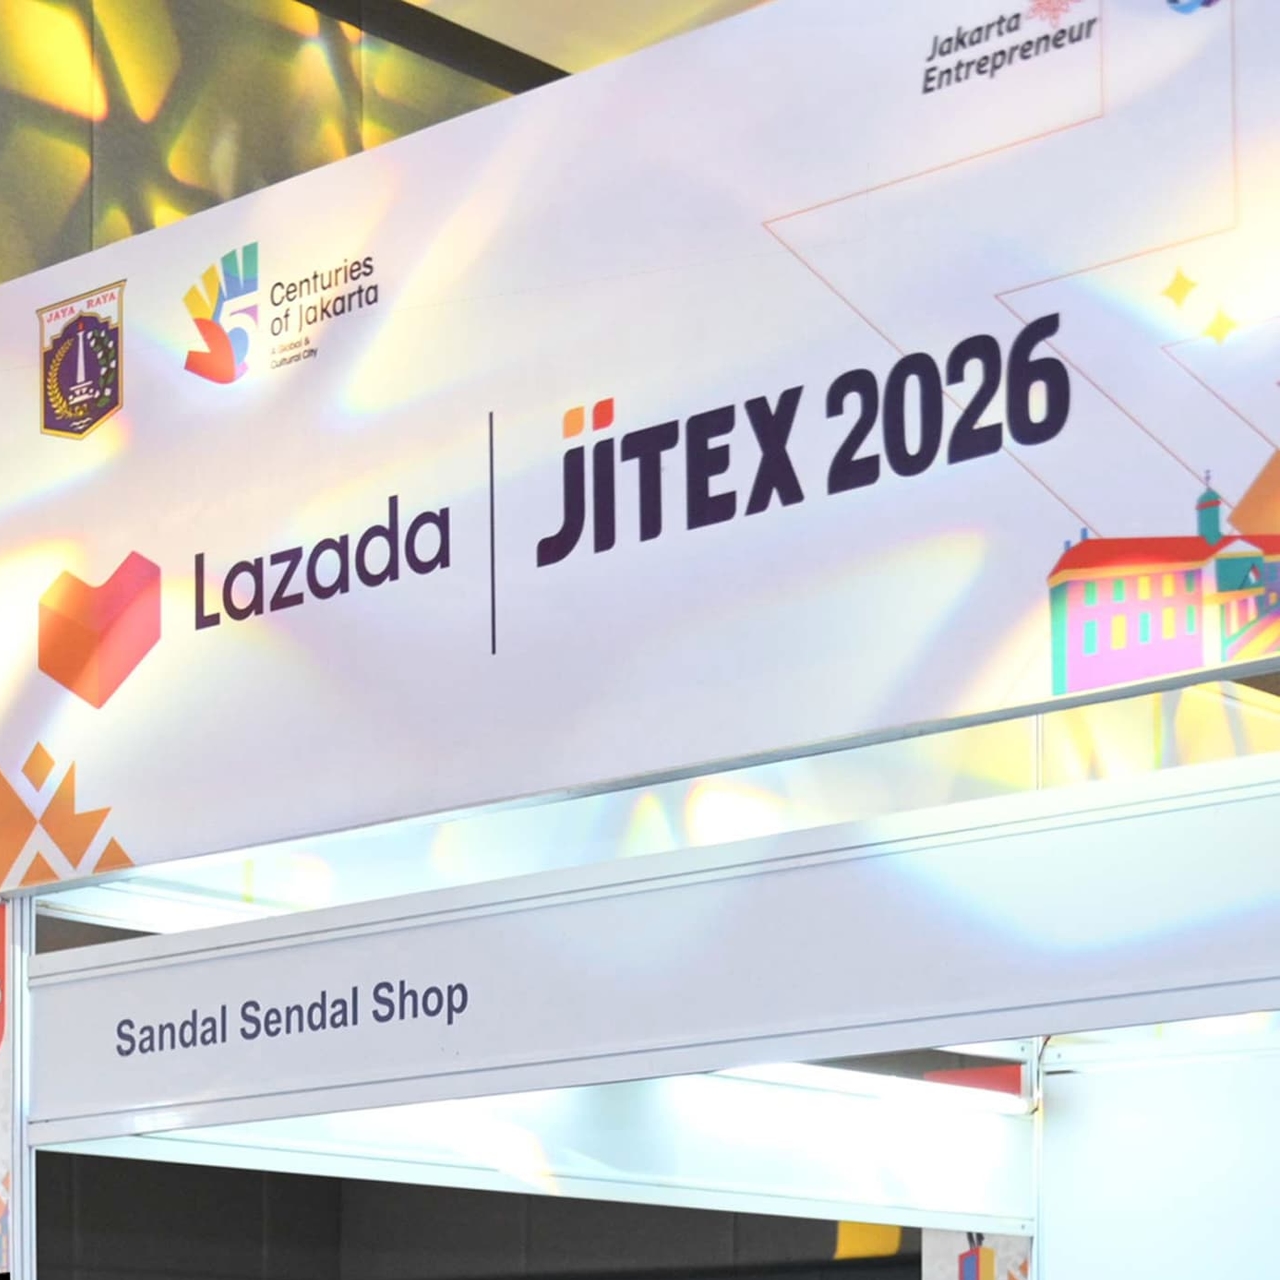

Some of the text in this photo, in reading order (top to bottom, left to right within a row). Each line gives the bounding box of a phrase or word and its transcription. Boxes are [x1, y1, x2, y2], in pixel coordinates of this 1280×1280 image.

[921, 16, 1097, 94] Entrepreneur
[925, 12, 1022, 62] Jakarta
[46, 291, 117, 324] JAYA RAYA
[270, 255, 374, 307] Centuries
[270, 281, 379, 336] of Jakarta
[270, 348, 318, 370] Cultural City
[825, 312, 1071, 496] 2026
[194, 494, 451, 631] Lazada
[116, 979, 469, 1058] Sandal Sendal Shop
